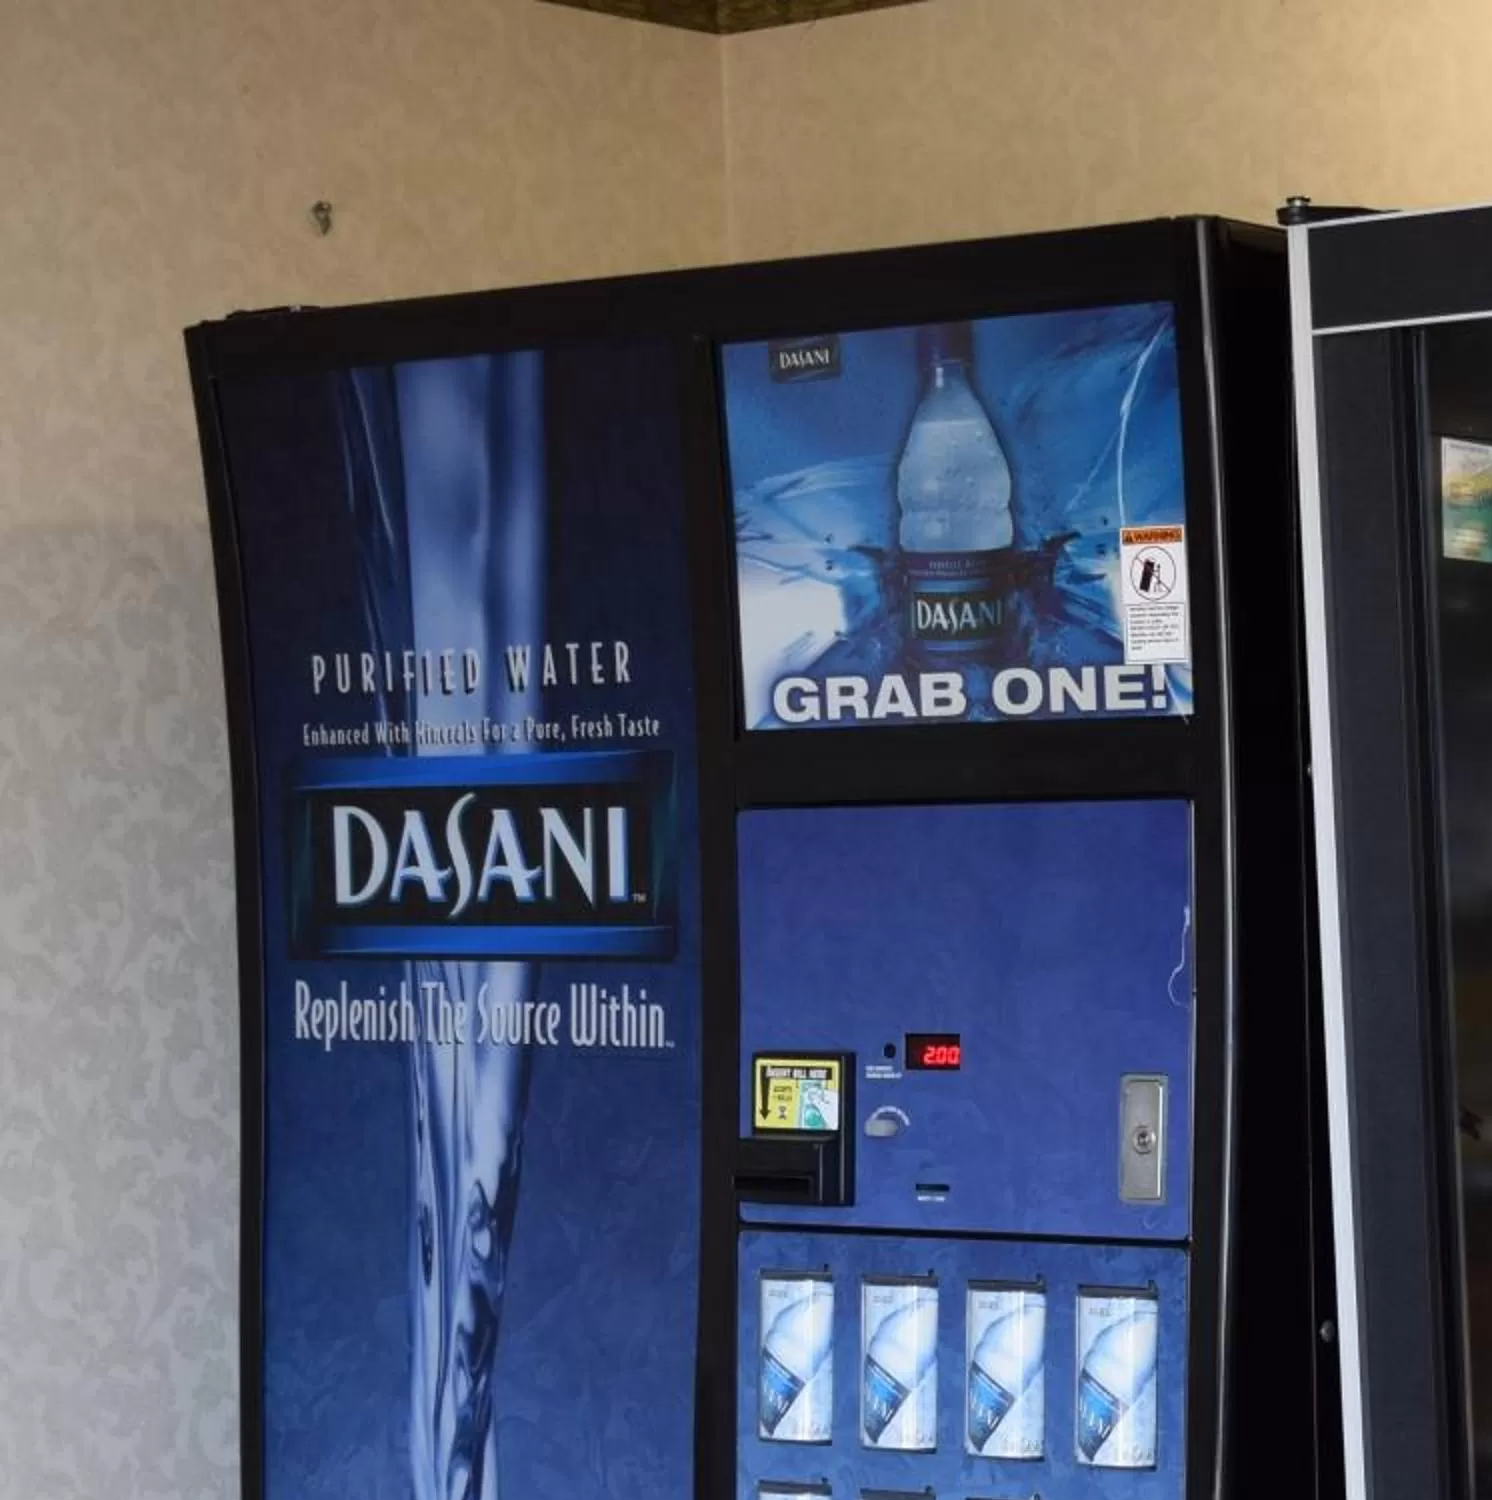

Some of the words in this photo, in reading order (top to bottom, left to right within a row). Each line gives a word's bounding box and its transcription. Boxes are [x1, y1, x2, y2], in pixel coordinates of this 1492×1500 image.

[778, 346, 831, 371] DASANI
[311, 649, 482, 696] PURIFIED
[506, 641, 633, 694] WATER
[773, 671, 967, 725] GRAB
[991, 662, 1168, 715] ONE!
[303, 722, 370, 747] Enhanced
[375, 720, 411, 745] With
[482, 717, 505, 743] For
[526, 716, 567, 744] Pure,
[571, 715, 613, 740] Fresh
[616, 712, 661, 738] Taste
[332, 792, 628, 919] DASANI
[294, 978, 415, 1053] Replenish
[420, 980, 468, 1047] The
[476, 980, 562, 1047] Source
[569, 982, 666, 1049] Within
